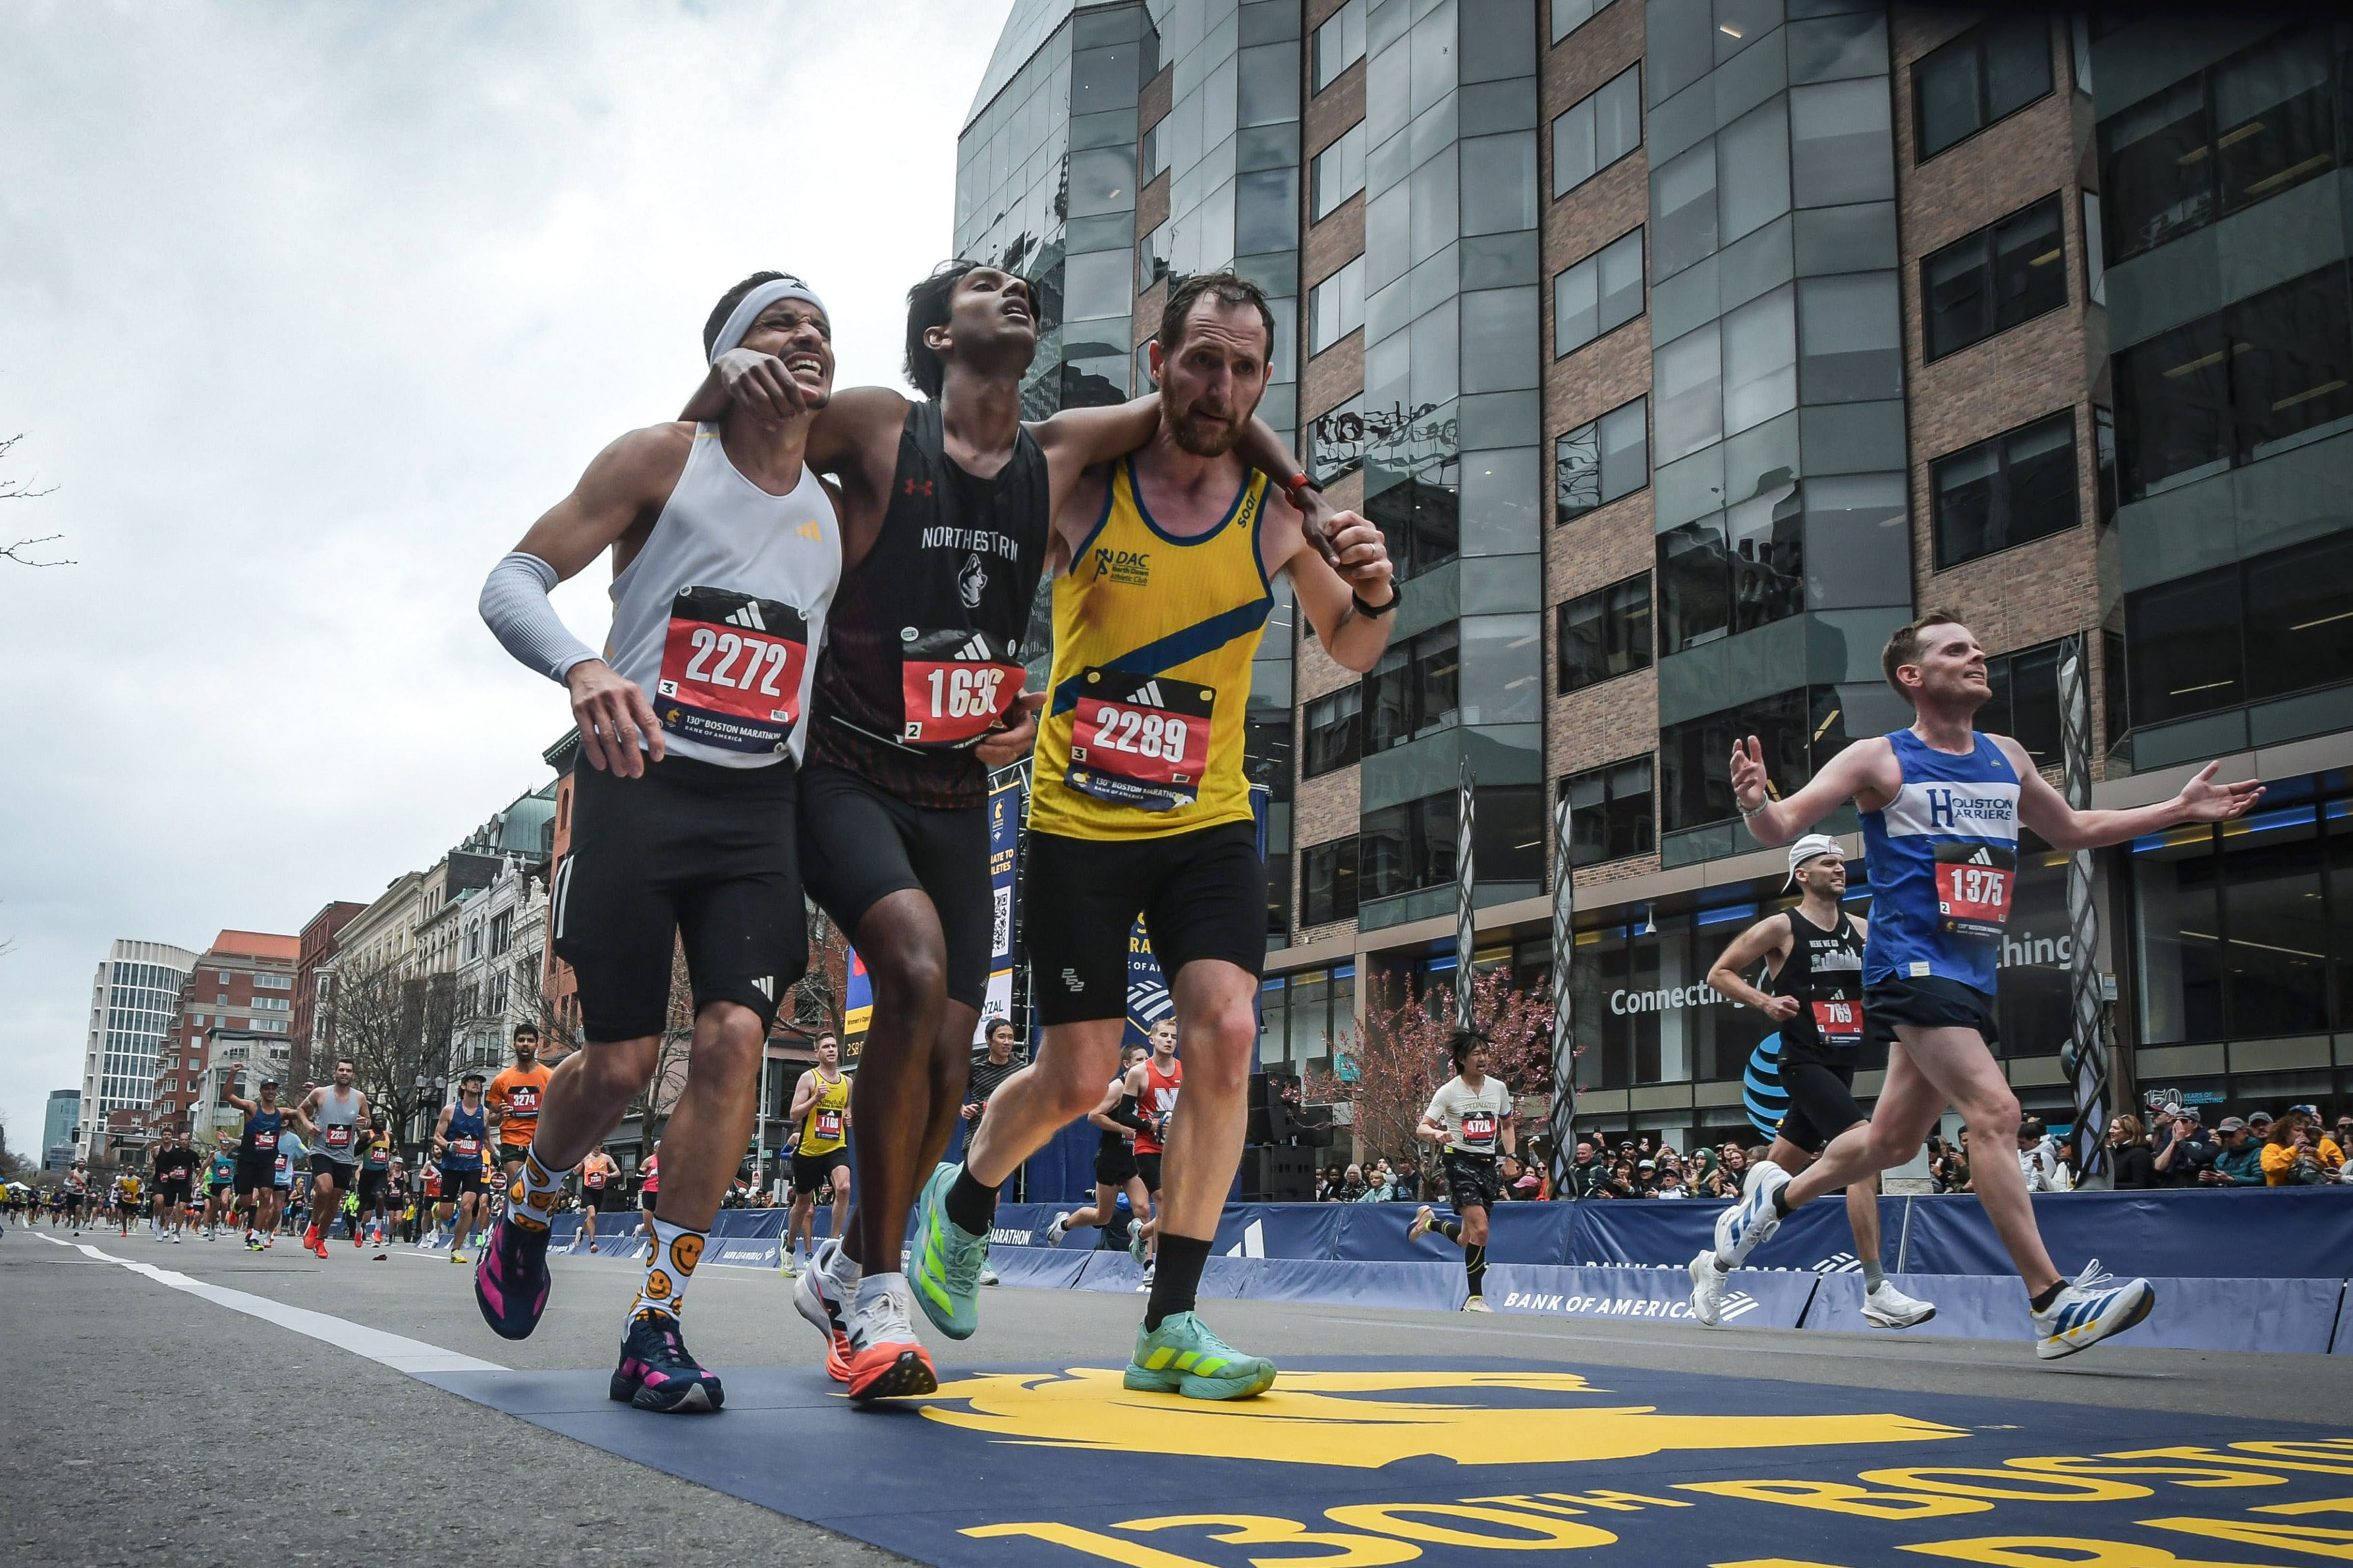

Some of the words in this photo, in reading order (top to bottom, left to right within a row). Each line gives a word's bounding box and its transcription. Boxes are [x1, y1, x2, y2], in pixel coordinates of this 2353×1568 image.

[1237, 491, 1256, 527] soar
[685, 629, 787, 697] 2272
[661, 682, 673, 693] 3
[684, 725, 703, 735] BANK
[713, 732, 742, 742] AMERICA
[704, 720, 738, 734] BOSTON
[739, 727, 781, 740] MARATHON
[908, 724, 918, 737] 2
[1093, 707, 1187, 763] 2289
[1074, 748, 1084, 759] 3
[1094, 786, 1111, 794] BANK
[1119, 791, 1144, 800] AMERICA
[1111, 782, 1142, 793] BOSTON
[1005, 848, 1014, 859] TO
[1951, 868, 2005, 907] 1375
[1941, 904, 1948, 912] 2
[1133, 961, 1147, 971] OF
[1824, 1003, 1852, 1023] 769
[513, 1094, 536, 1106] 3274
[1154, 1087, 1180, 1112] N
[2143, 1088, 2182, 1109] 150
[1467, 1120, 1491, 1133] 4728
[1503, 1291, 1560, 1311] BANK
[1565, 1295, 1595, 1313] OF
[1594, 1297, 1698, 1319] AMERICA
